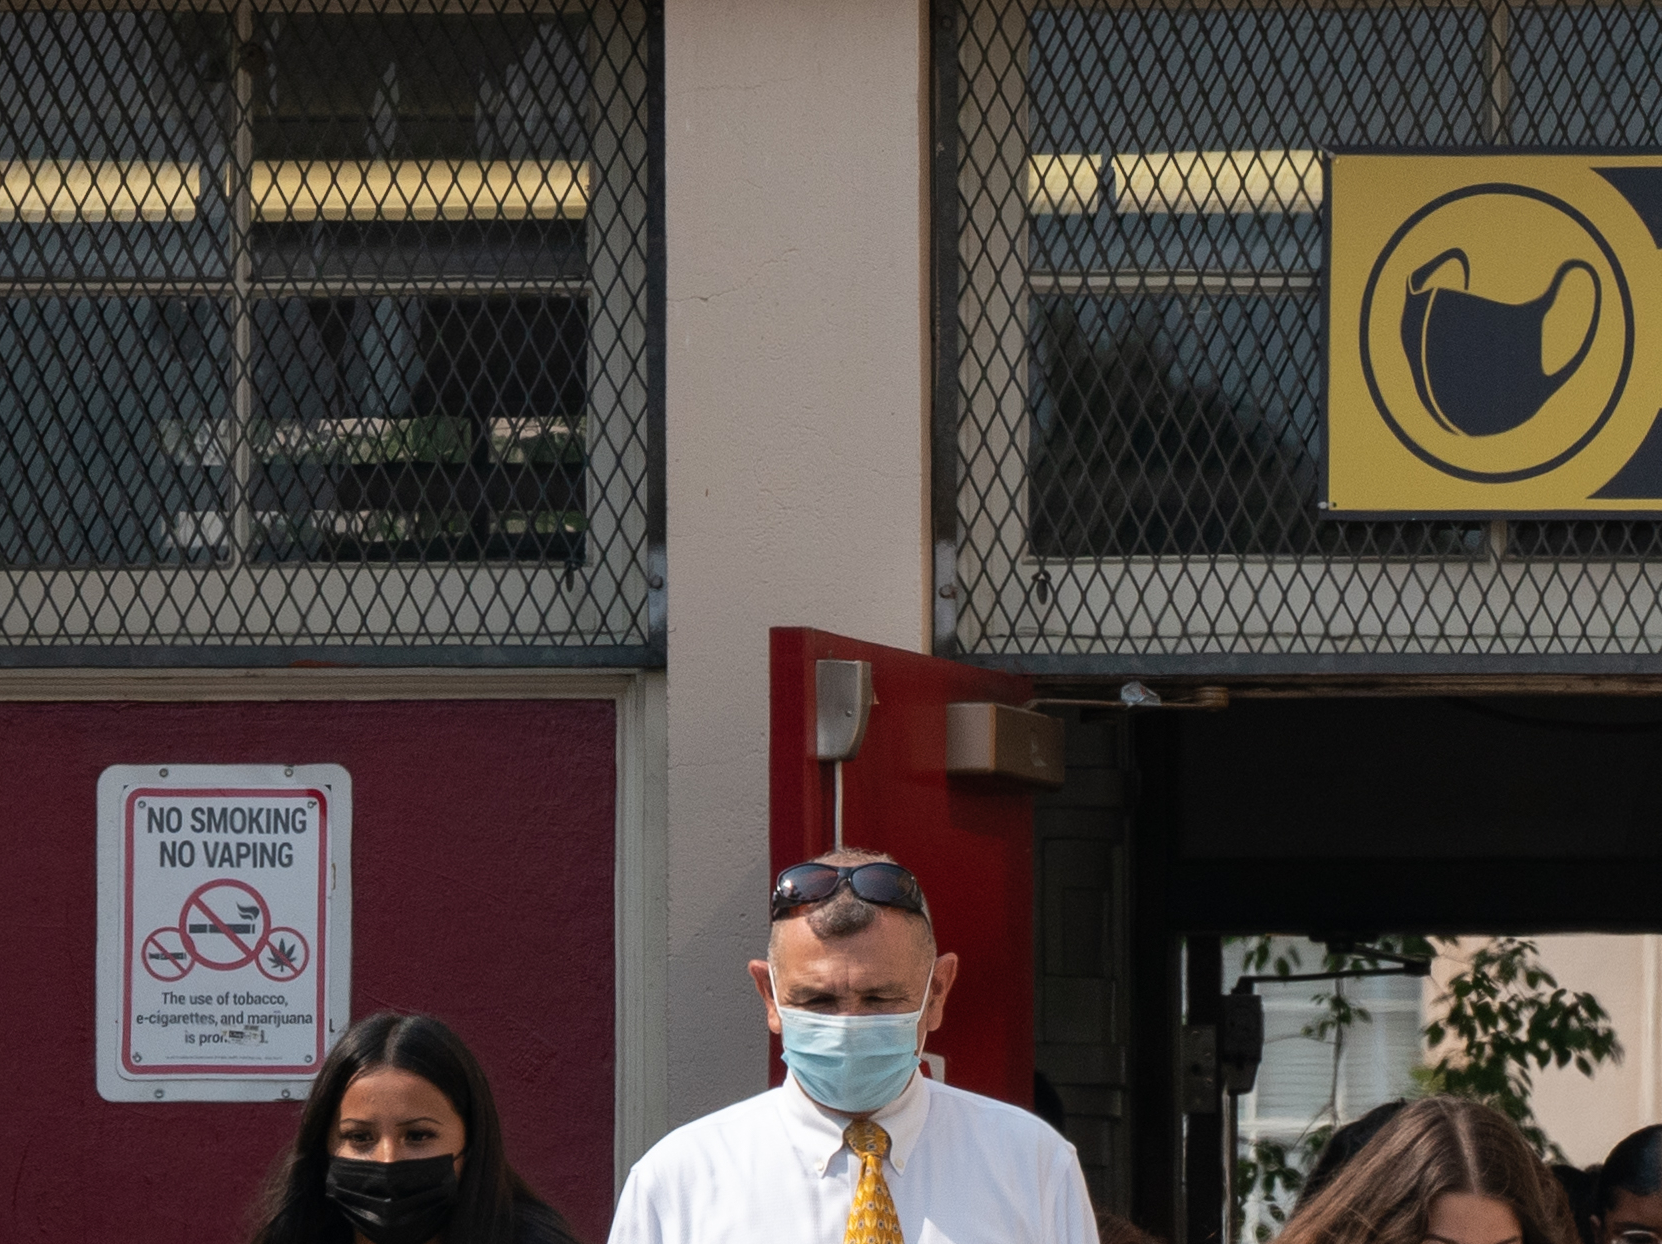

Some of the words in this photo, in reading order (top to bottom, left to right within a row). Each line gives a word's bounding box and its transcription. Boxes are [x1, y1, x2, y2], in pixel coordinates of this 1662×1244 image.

[147, 807, 182, 833] NO
[190, 807, 307, 834] SMOKING
[160, 841, 195, 867] NO
[203, 841, 293, 868] VAPING
[162, 992, 185, 1005] The
[190, 994, 212, 1005] use
[217, 992, 230, 1005] of
[233, 992, 288, 1007] tobacco,
[137, 1011, 218, 1027] e-cigarettes,
[221, 1012, 243, 1025] and
[248, 1011, 313, 1028] marijuana
[185, 1031, 195, 1043] is
